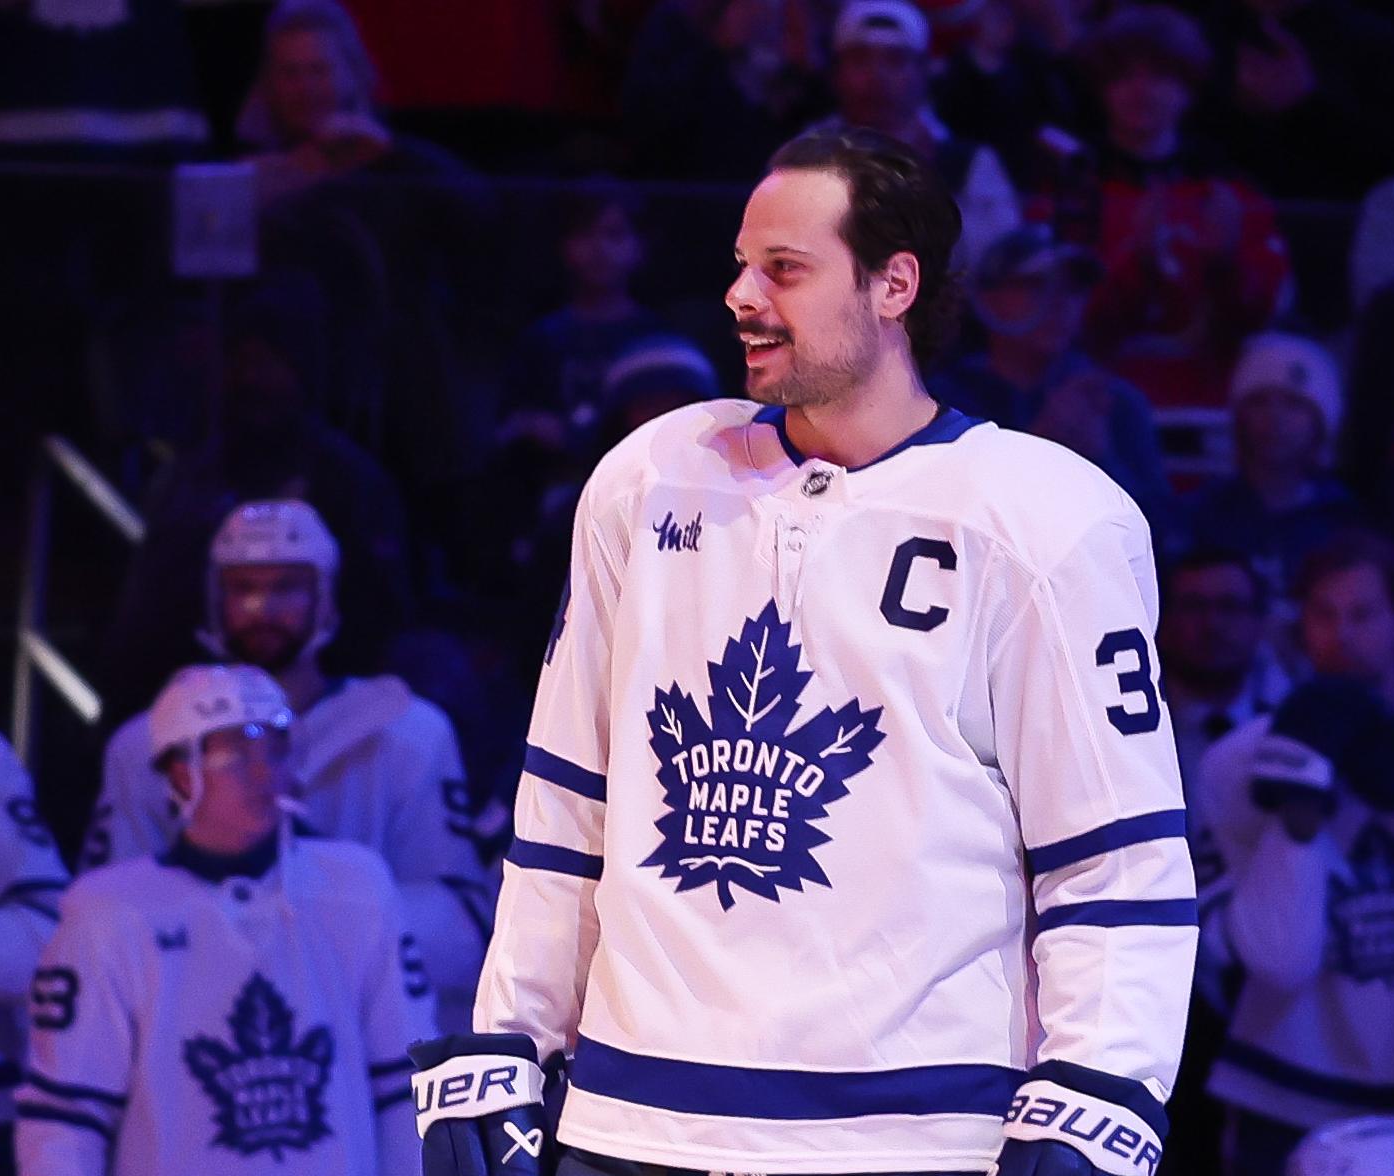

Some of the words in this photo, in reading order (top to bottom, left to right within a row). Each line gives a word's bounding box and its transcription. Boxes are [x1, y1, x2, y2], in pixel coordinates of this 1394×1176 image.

[879, 536, 957, 632] C
[1095, 627, 1166, 735] 3
[671, 738, 825, 798] TORONTO
[688, 780, 793, 819] MAPLE
[683, 814, 787, 852] LEAFS
